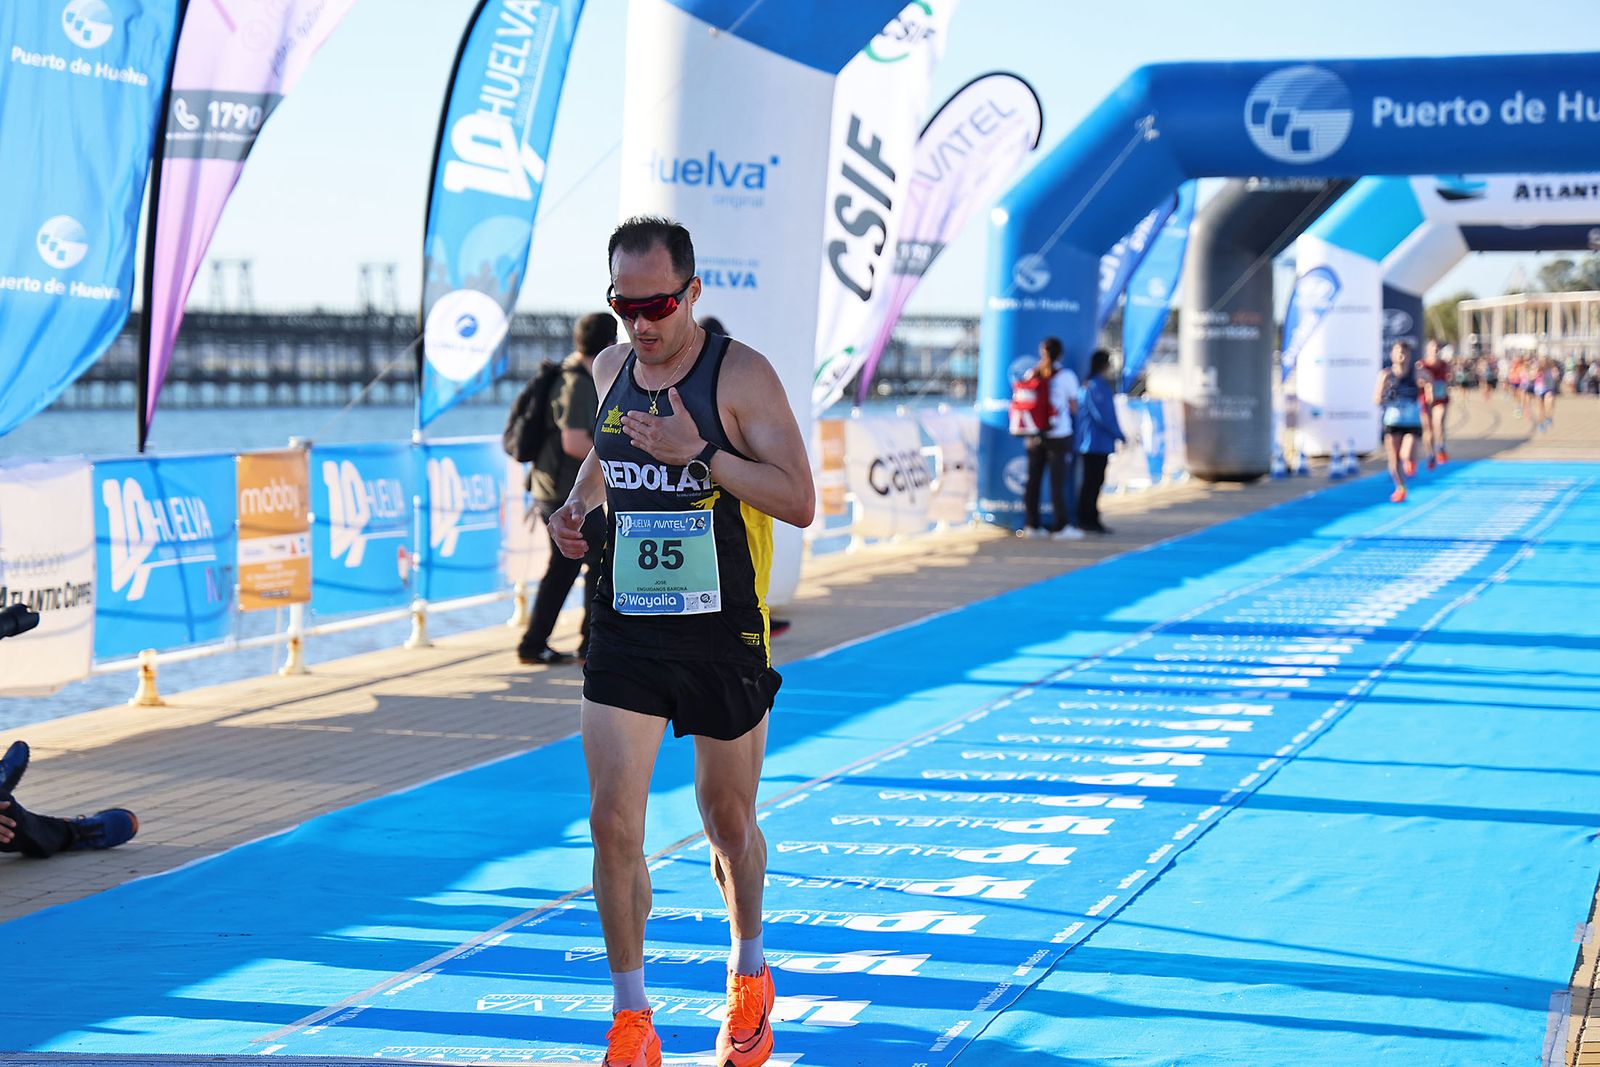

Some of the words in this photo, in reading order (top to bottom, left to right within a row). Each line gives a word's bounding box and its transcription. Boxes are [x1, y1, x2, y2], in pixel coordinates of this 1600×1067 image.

[11, 46, 66, 72] Puerto
[70, 58, 92, 76] de
[94, 61, 149, 87] Huelva
[477, 0, 543, 123] HUELVA
[207, 100, 263, 131] 1790
[1372, 95, 1491, 128] Puerto
[1501, 91, 1546, 125] de
[828, 112, 896, 302] CSIF
[44, 278, 66, 297] de
[239, 476, 300, 519] mobby
[150, 496, 214, 544] HUELVA
[638, 539, 684, 570] 85
[628, 594, 677, 608] Wayalia
[776, 840, 962, 858] HUELVA
[764, 875, 913, 892] HUEL
[483, 993, 613, 1001] ESCUBRIMIENTO
